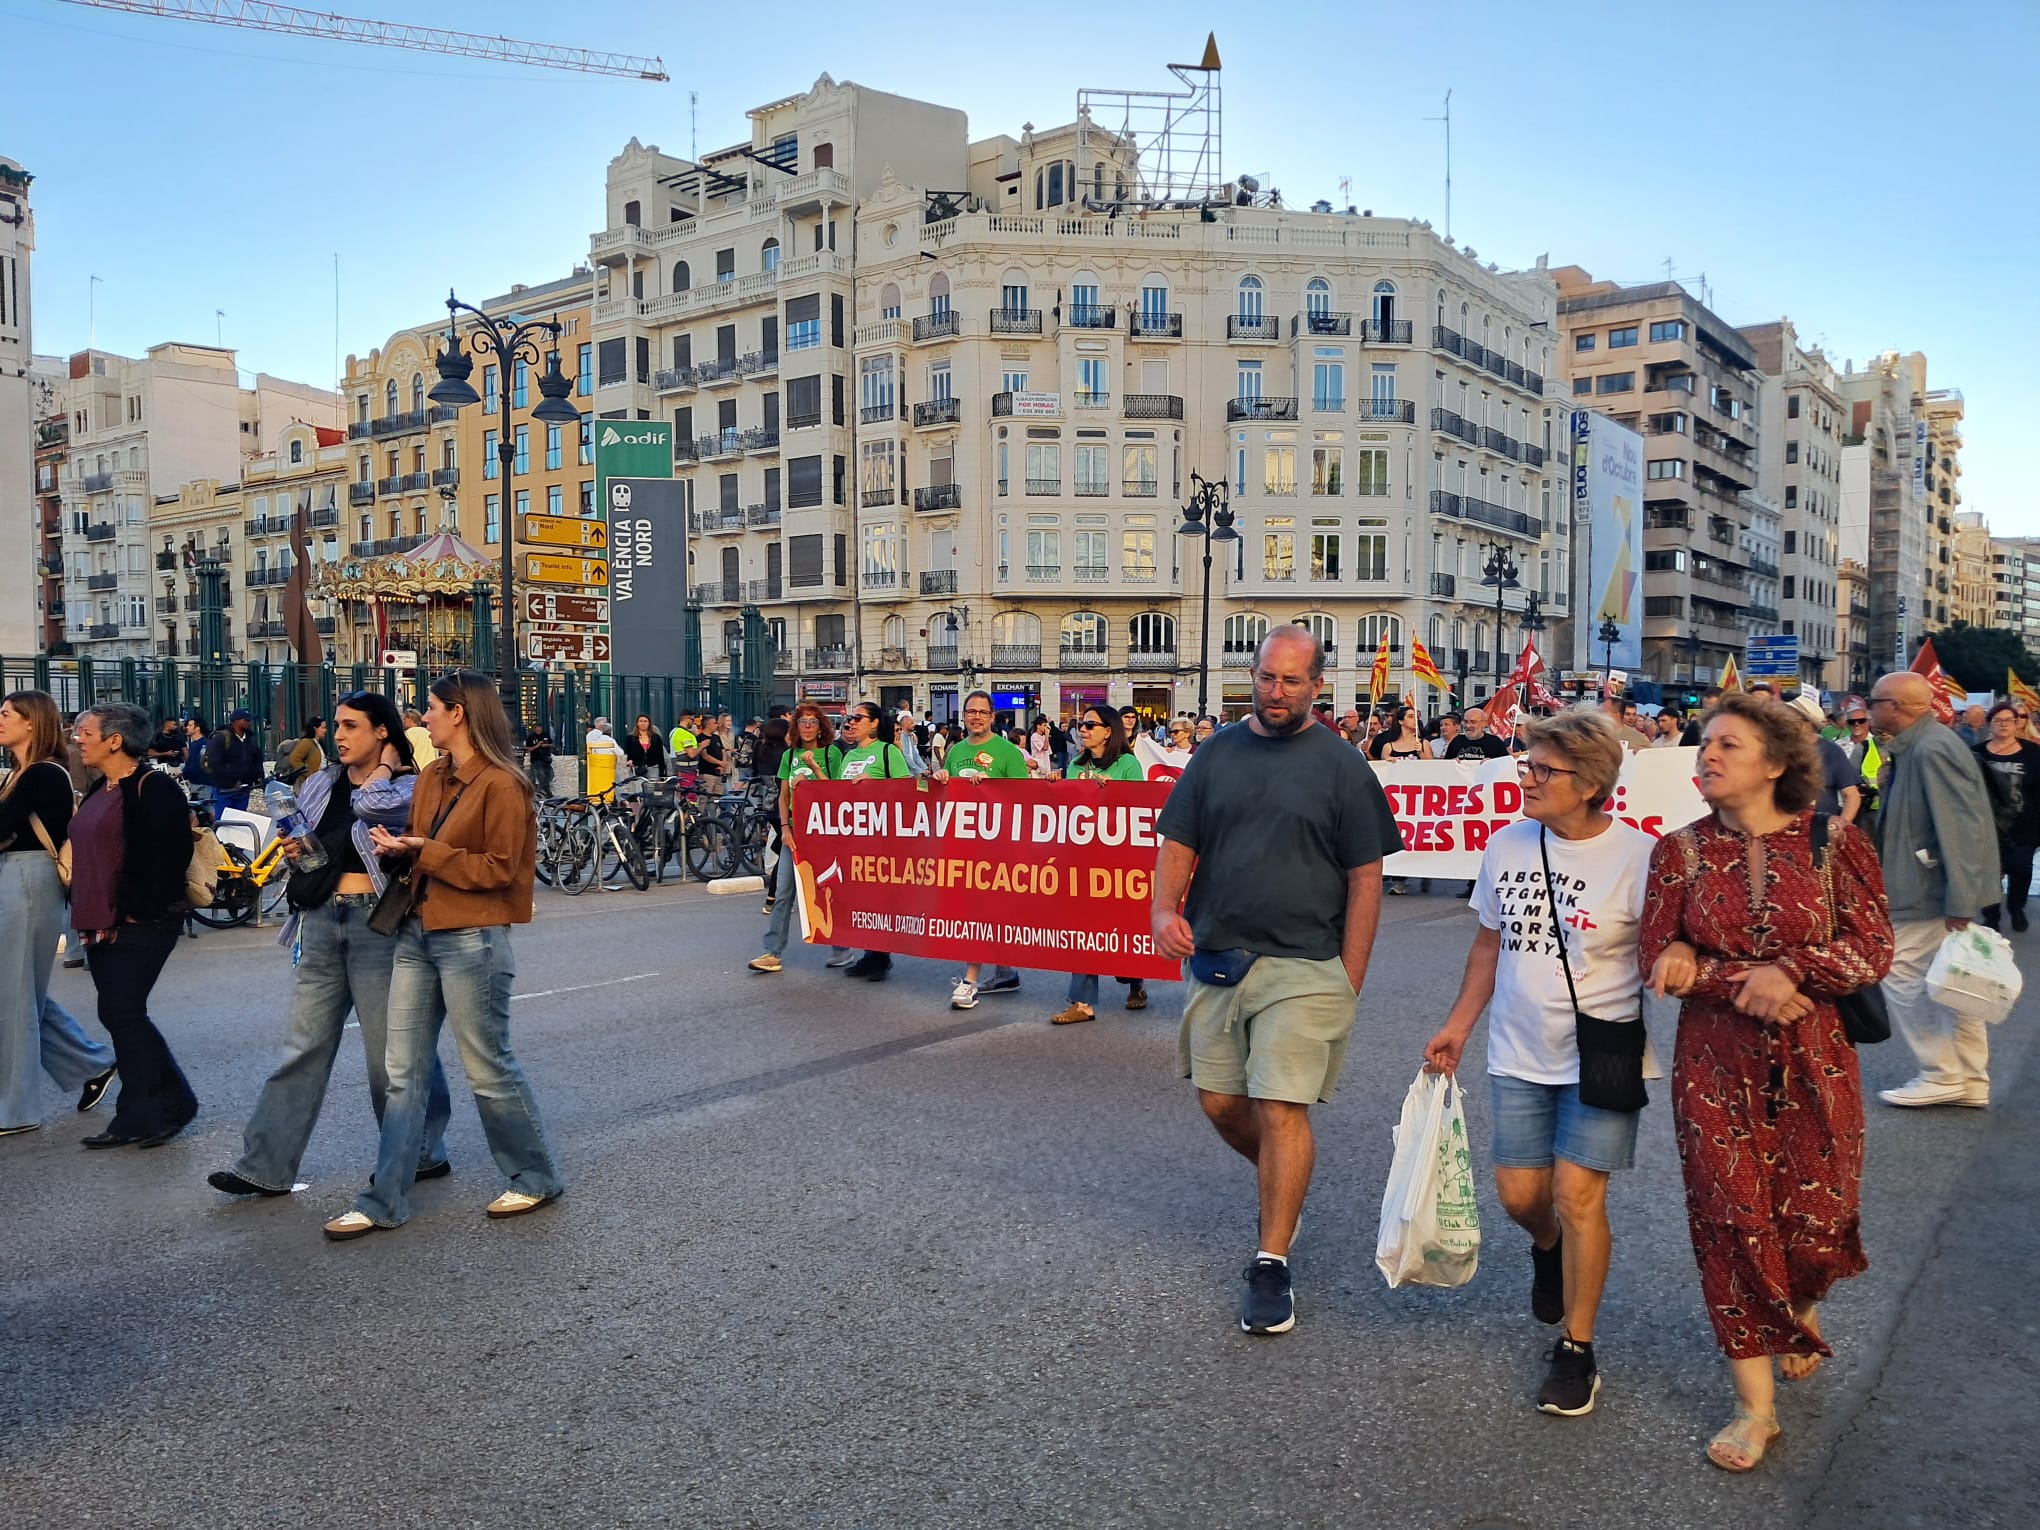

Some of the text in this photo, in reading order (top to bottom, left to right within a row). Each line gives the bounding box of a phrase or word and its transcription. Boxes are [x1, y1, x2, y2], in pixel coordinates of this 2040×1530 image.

[623, 431, 668, 445] adif
[612, 519, 633, 601] VALÈNCIA
[635, 518, 653, 566] NORD
[996, 683, 1035, 691] EXCHANE
[806, 801, 888, 837] ALCEM
[895, 801, 931, 837] LA
[935, 801, 1002, 841] VEU
[1011, 803, 1021, 842] I
[851, 855, 1059, 897] RECLASSIFICACIÓ
[1069, 866, 1078, 897] I
[851, 910, 893, 932] PERSONAL
[895, 912, 925, 936] D'ATENCIÓ
[928, 918, 994, 943] EDUCATIVA
[996, 923, 1001, 943] I
[1004, 924, 1119, 953] D'ADMINISTRACIÓ
[1124, 933, 1128, 953] I
